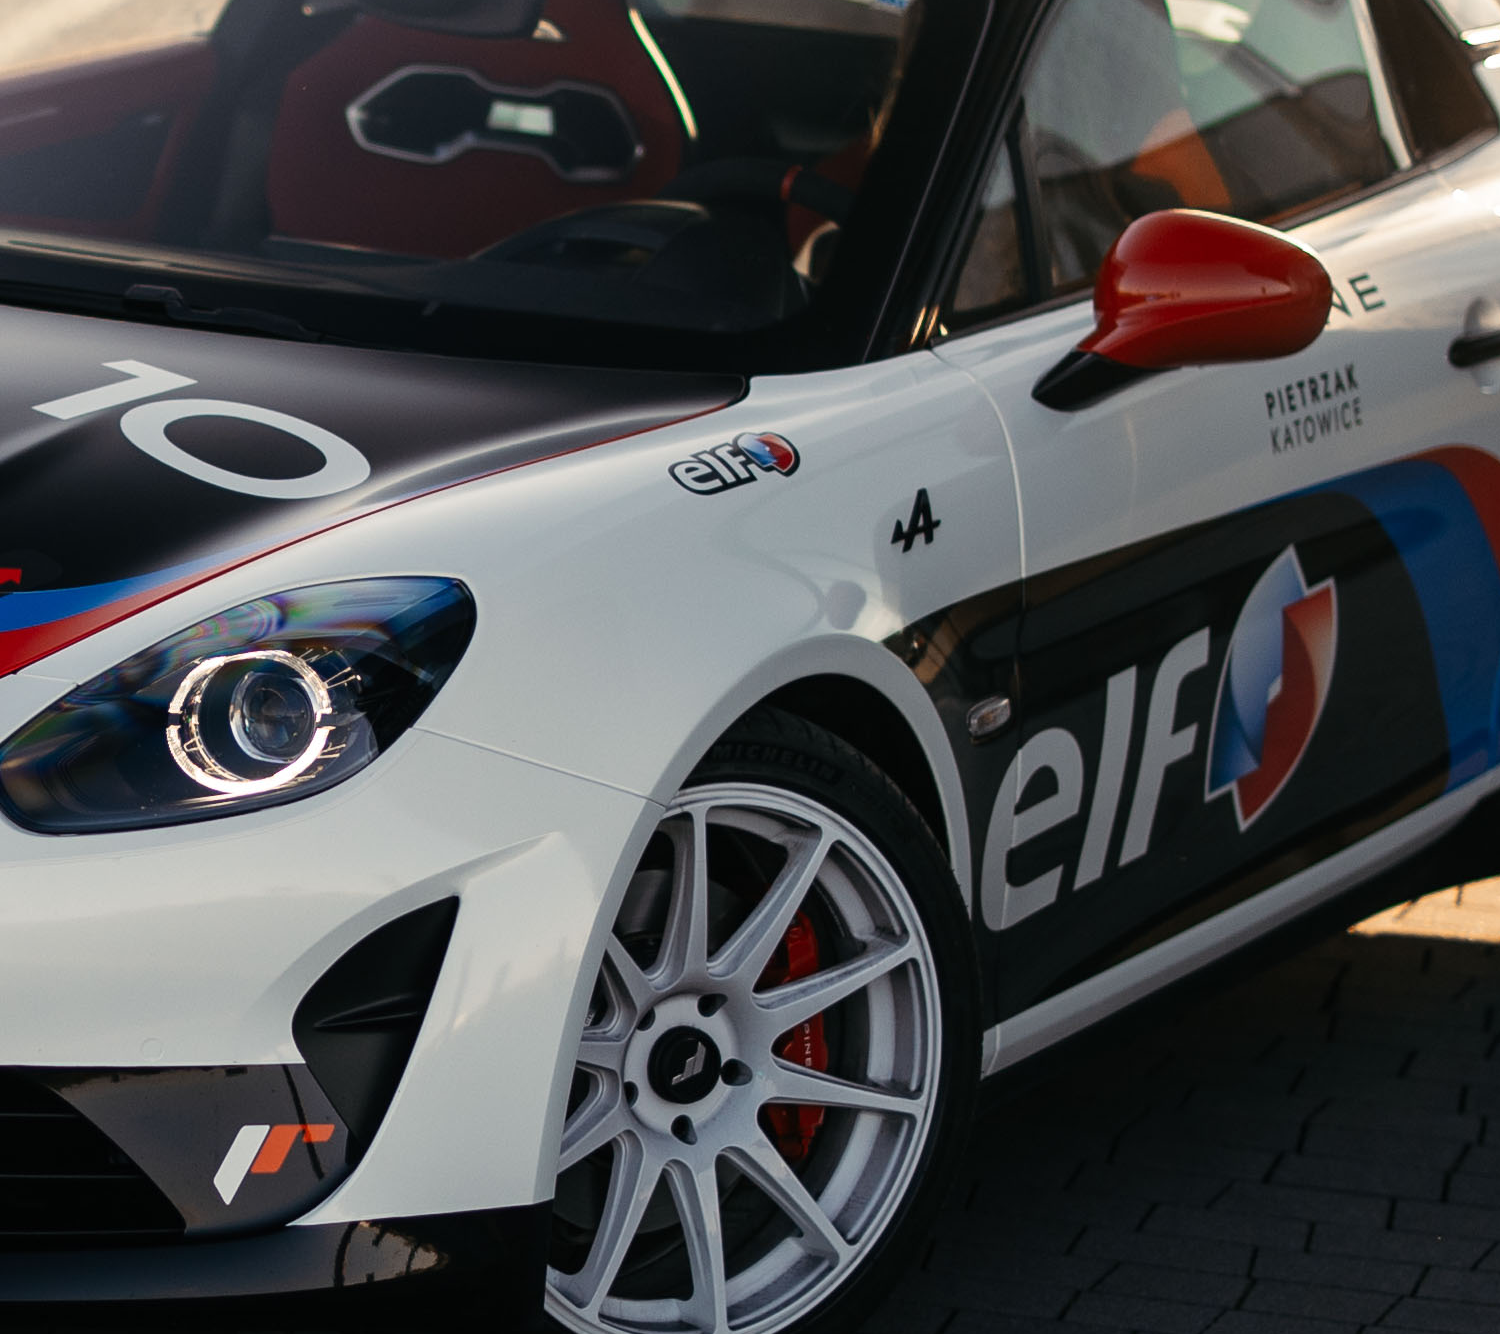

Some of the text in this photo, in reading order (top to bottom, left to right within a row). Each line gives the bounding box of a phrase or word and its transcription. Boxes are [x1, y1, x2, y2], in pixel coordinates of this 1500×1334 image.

[1265, 363, 1359, 420] PIETRZAK
[31, 358, 372, 500] 10
[1270, 397, 1363, 455] KATOWICE
[672, 443, 752, 493] elf
[978, 625, 1211, 932] elf
[803, 1023, 812, 1067] PINE
